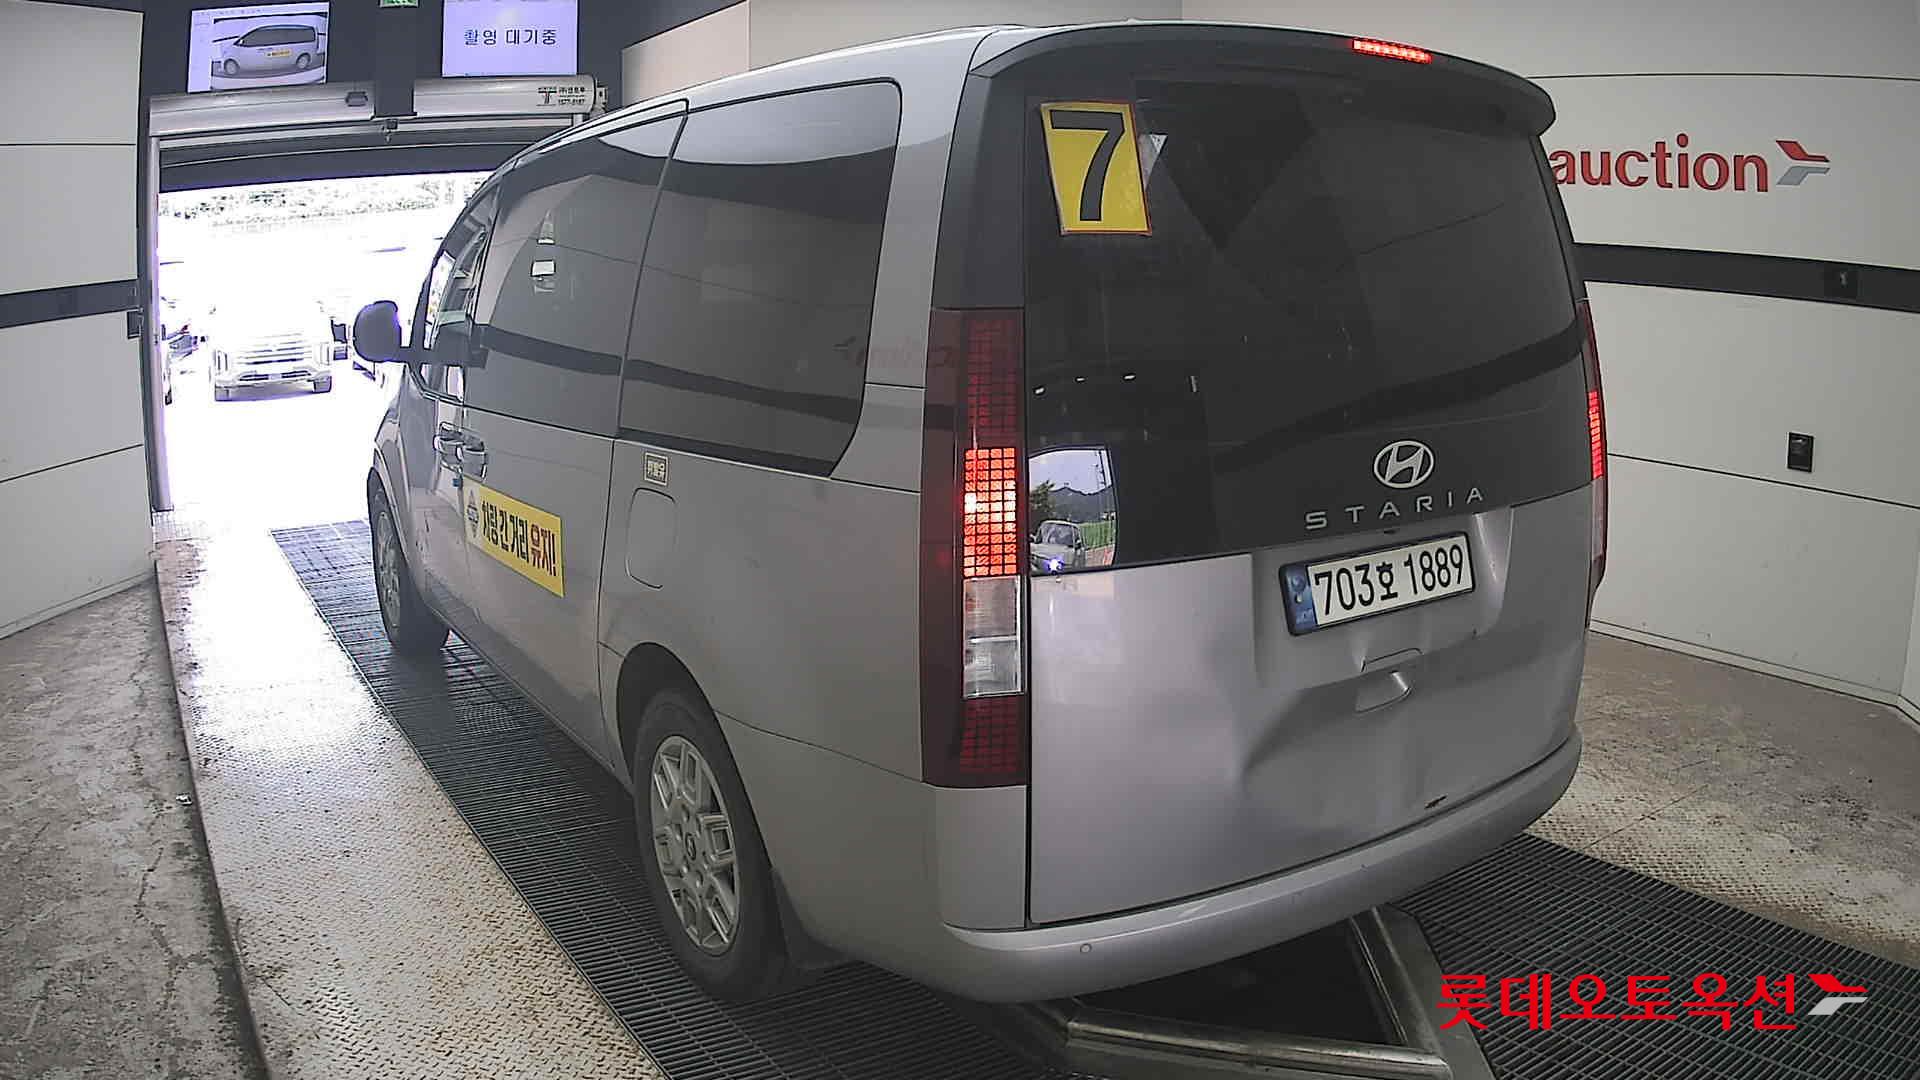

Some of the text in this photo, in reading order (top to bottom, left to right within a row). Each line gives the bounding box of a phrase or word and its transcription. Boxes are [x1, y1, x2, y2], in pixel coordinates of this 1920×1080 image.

[505, 29, 557, 46] 대기중
[1048, 109, 1125, 222] 7
[1549, 132, 1769, 193] auction
[1304, 487, 1484, 530] STARIA
[1314, 543, 1464, 616] 703호 1889
